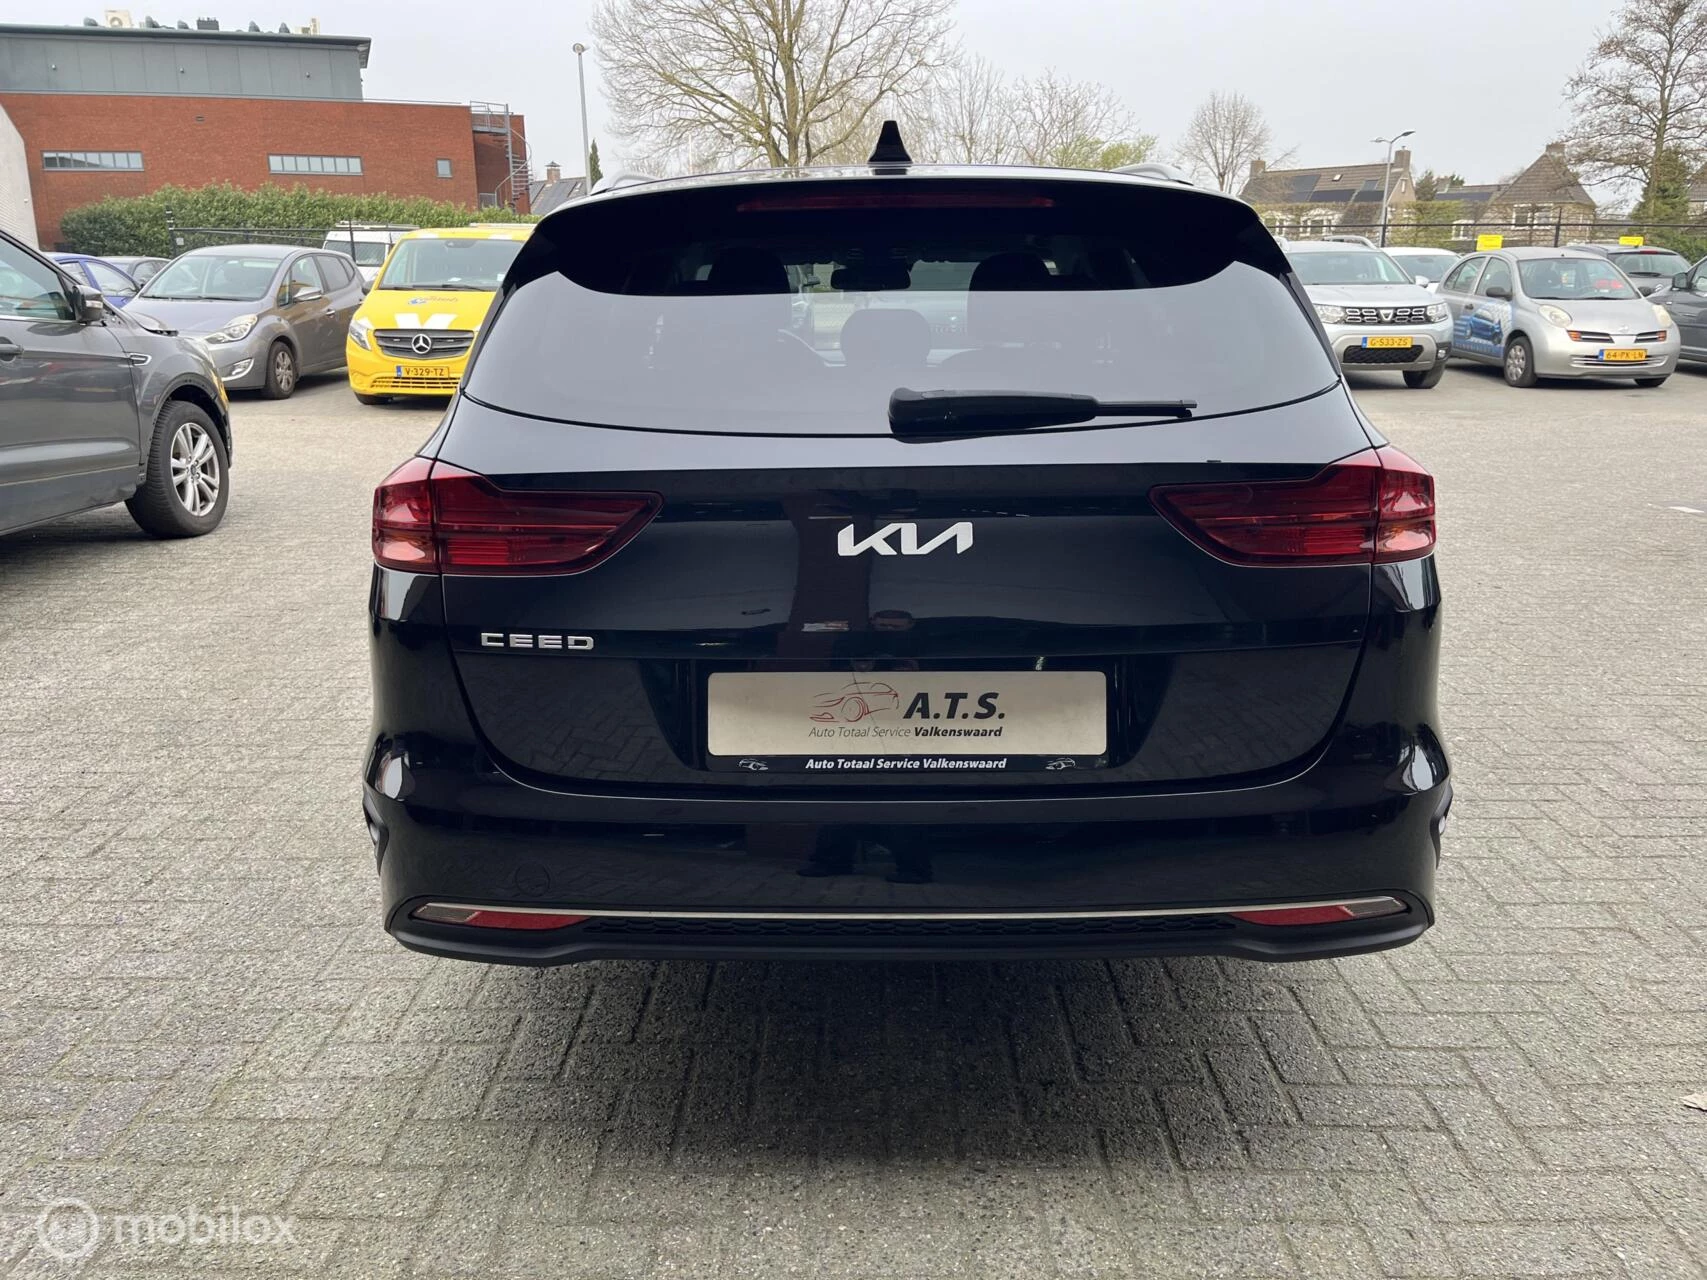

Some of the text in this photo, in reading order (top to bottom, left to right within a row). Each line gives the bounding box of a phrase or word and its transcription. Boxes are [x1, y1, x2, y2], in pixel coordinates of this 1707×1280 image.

[404, 367, 445, 377] V-329-TZ
[837, 521, 974, 557] KIA
[480, 632, 595, 650] CEED
[902, 691, 1006, 720] A.T.S.
[808, 726, 1003, 738] Auto Totaal Service Valkenswaard
[805, 757, 1007, 769] Auto Totaal Service Valkenswaard
